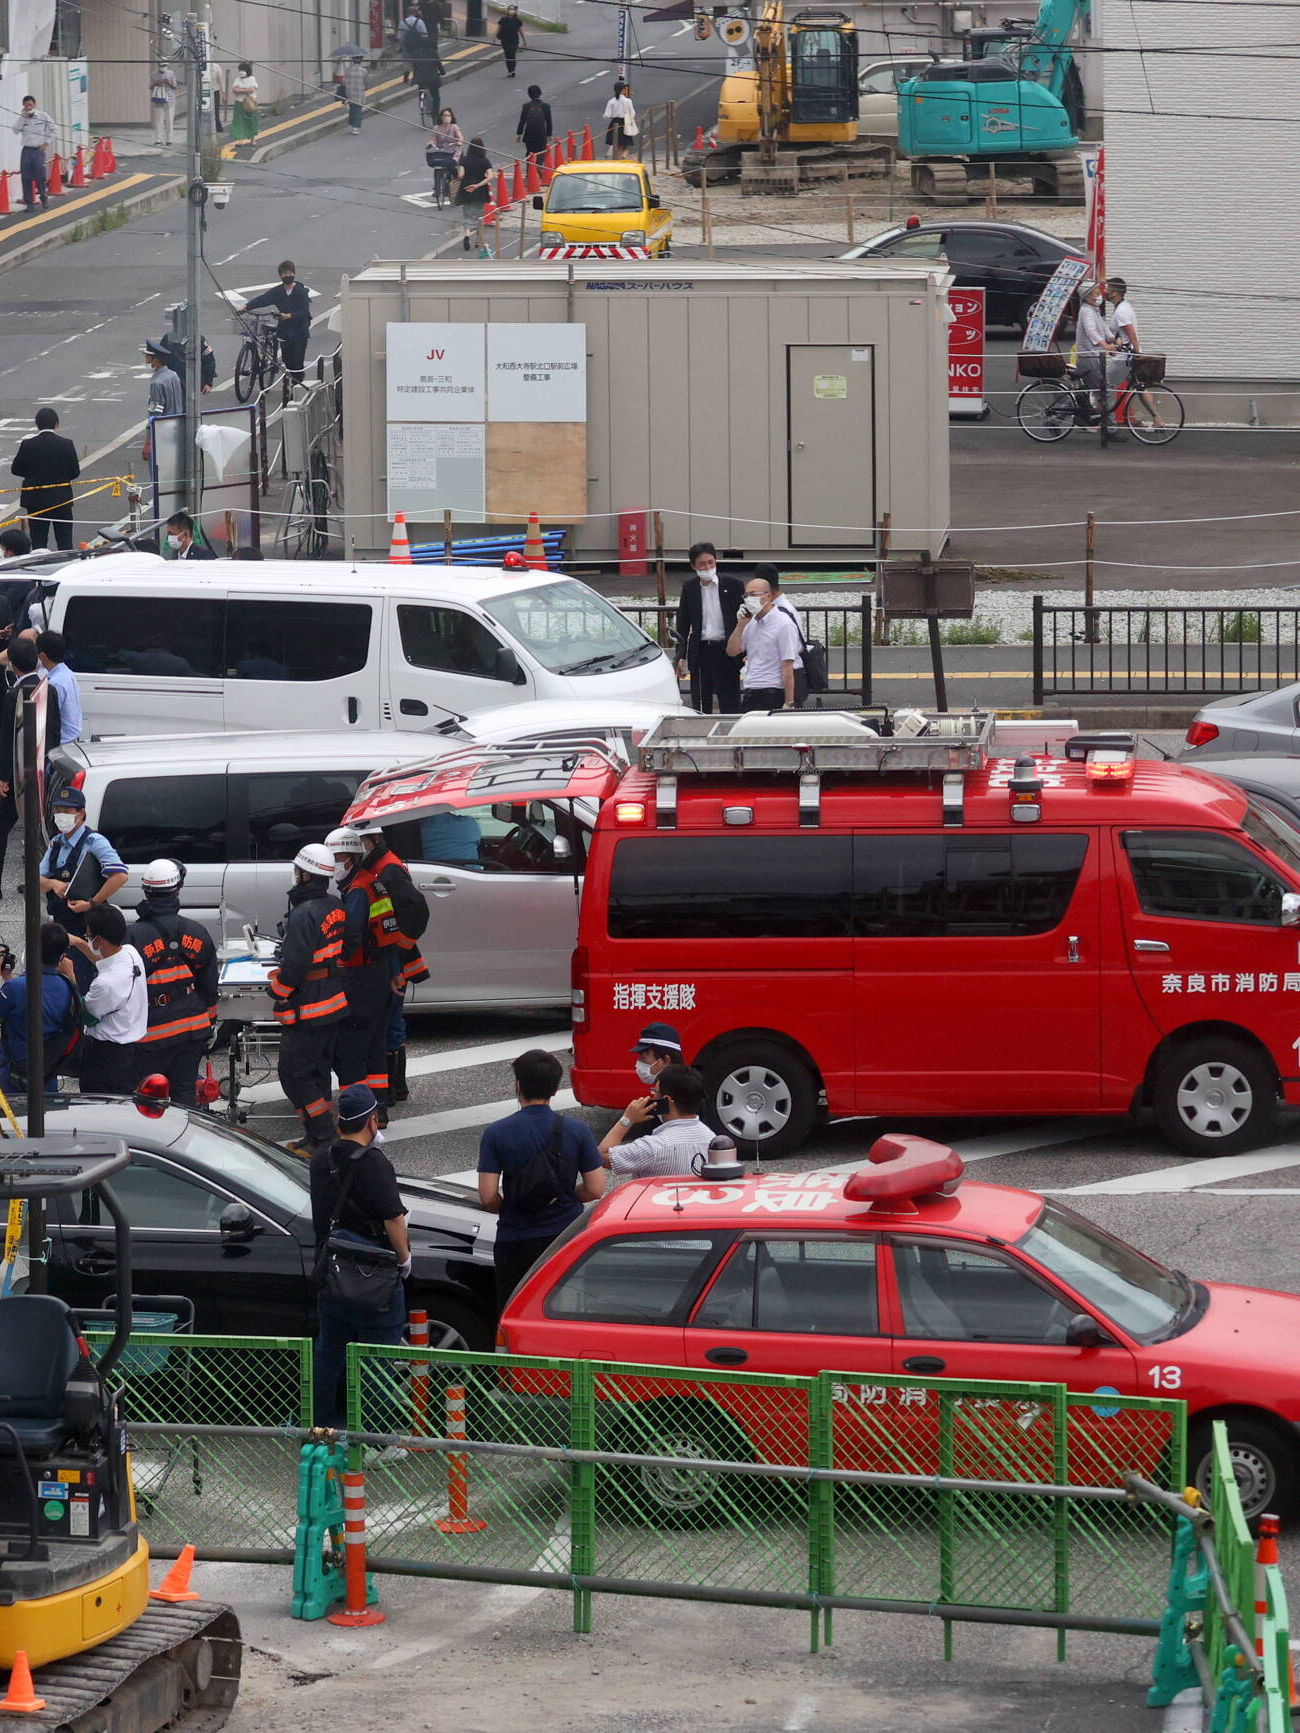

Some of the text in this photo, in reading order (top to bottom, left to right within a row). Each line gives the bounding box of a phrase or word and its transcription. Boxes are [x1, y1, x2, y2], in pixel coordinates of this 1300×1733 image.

[627, 282, 694, 290] スーパーハウス
[426, 349, 445, 361] JV
[495, 361, 578, 371] 大和西大寺駅北口駅前広場
[523, 373, 551, 382] 整備工事
[143, 934, 204, 958] 奈良防局
[1162, 972, 1300, 993] 奈良市消防局
[613, 983, 696, 1010] 指揮支援隊
[1149, 1366, 1182, 1390] 13
